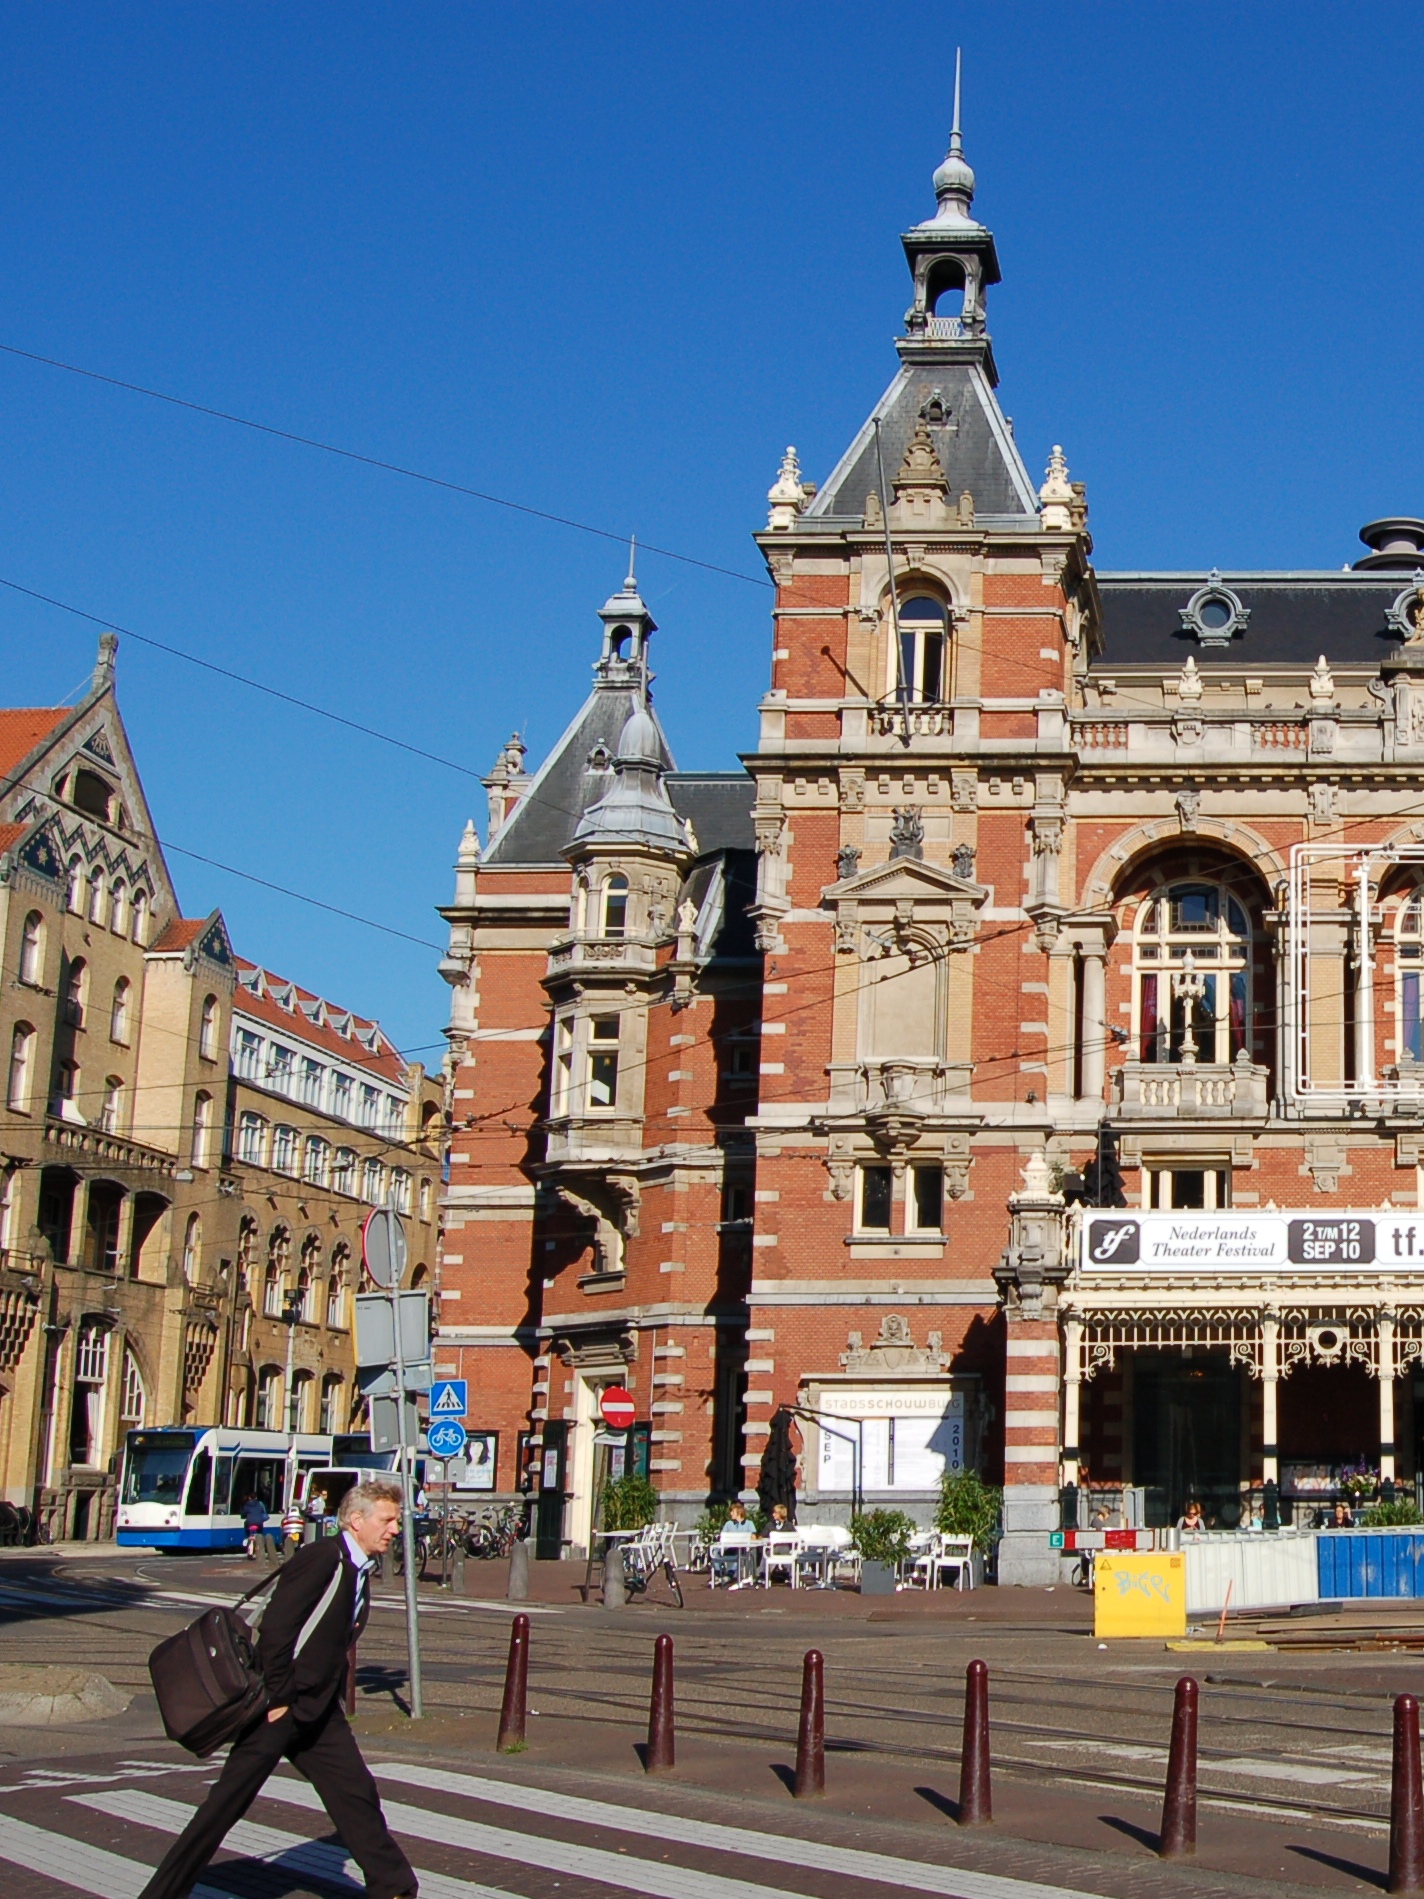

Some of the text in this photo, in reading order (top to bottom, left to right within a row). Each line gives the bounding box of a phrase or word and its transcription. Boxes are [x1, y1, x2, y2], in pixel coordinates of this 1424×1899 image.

[1169, 1226, 1257, 1240] Nederlands
[1302, 1222, 1361, 1240] 2 T/M 12
[1094, 1224, 1136, 1260] tf
[1152, 1243, 1275, 1258] Theater Festival
[1302, 1241, 1361, 1260] SEP 10
[824, 1431, 832, 1464] SEP
[952, 1424, 960, 1470] 2010
[1052, 1535, 1061, 1546] E
